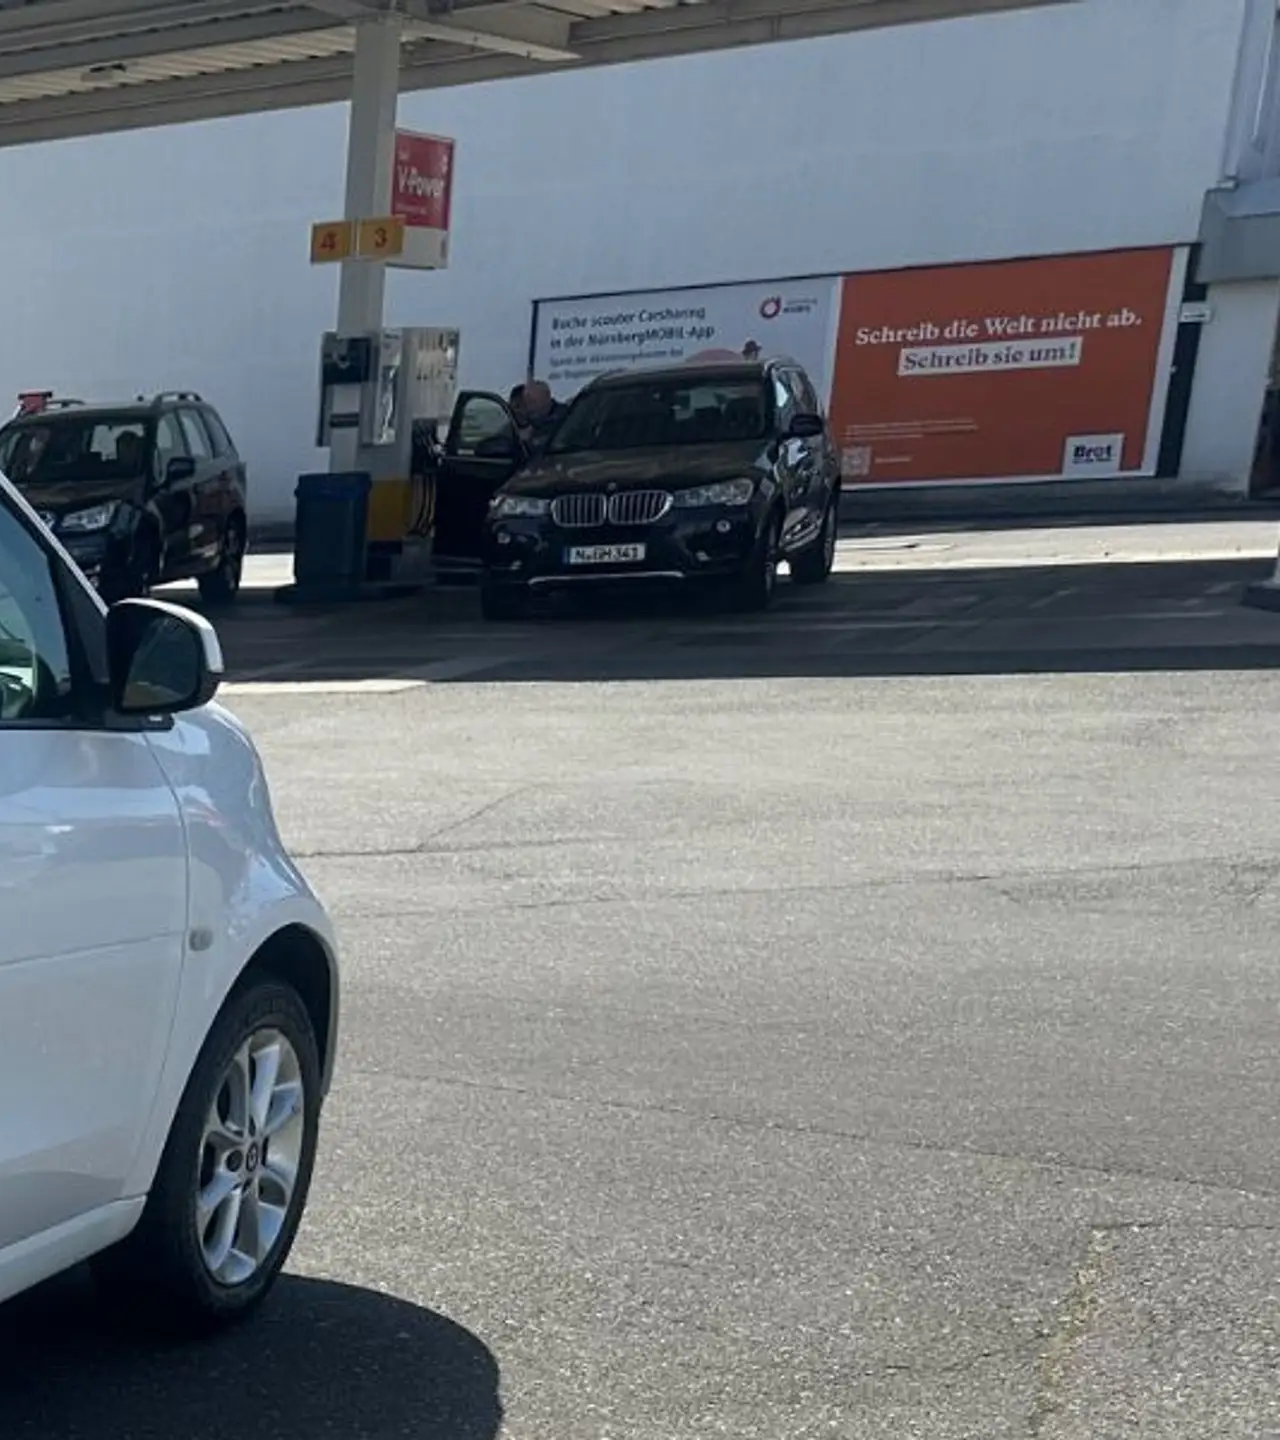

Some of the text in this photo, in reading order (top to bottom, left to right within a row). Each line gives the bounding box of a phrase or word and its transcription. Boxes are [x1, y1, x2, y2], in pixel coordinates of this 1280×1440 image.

[397, 165, 445, 196] V-Power
[319, 231, 336, 250] 4
[374, 227, 387, 248] 3
[639, 307, 706, 322] Carsharing
[855, 307, 1142, 345] Schreib die Welt nicht ab.
[564, 334, 585, 348] der
[904, 342, 1077, 371] Schreib sie um!
